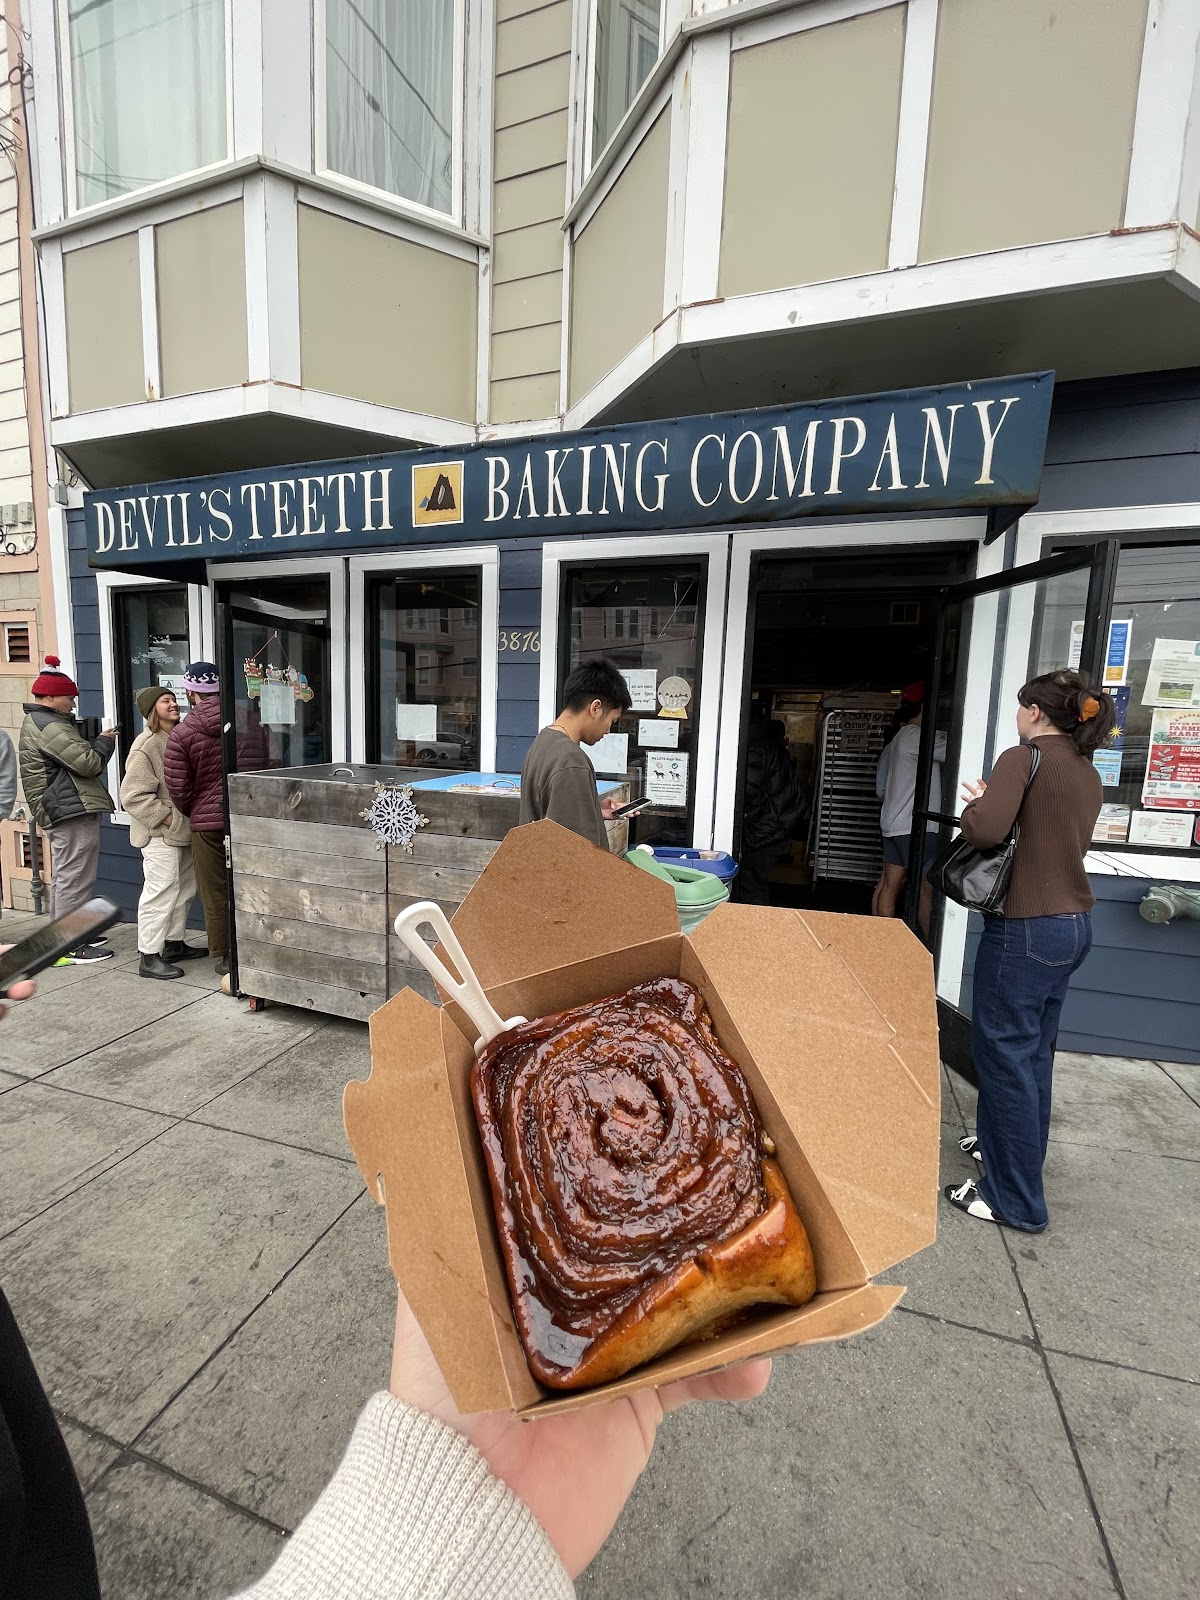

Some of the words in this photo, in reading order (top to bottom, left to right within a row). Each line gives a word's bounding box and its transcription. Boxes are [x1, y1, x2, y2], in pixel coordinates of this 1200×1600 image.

[93, 487, 233, 553] DEVIL'S
[241, 468, 394, 540] TEETH
[483, 438, 670, 522] BAKING
[690, 397, 1021, 507] COMPANY
[497, 631, 541, 652] 3876
